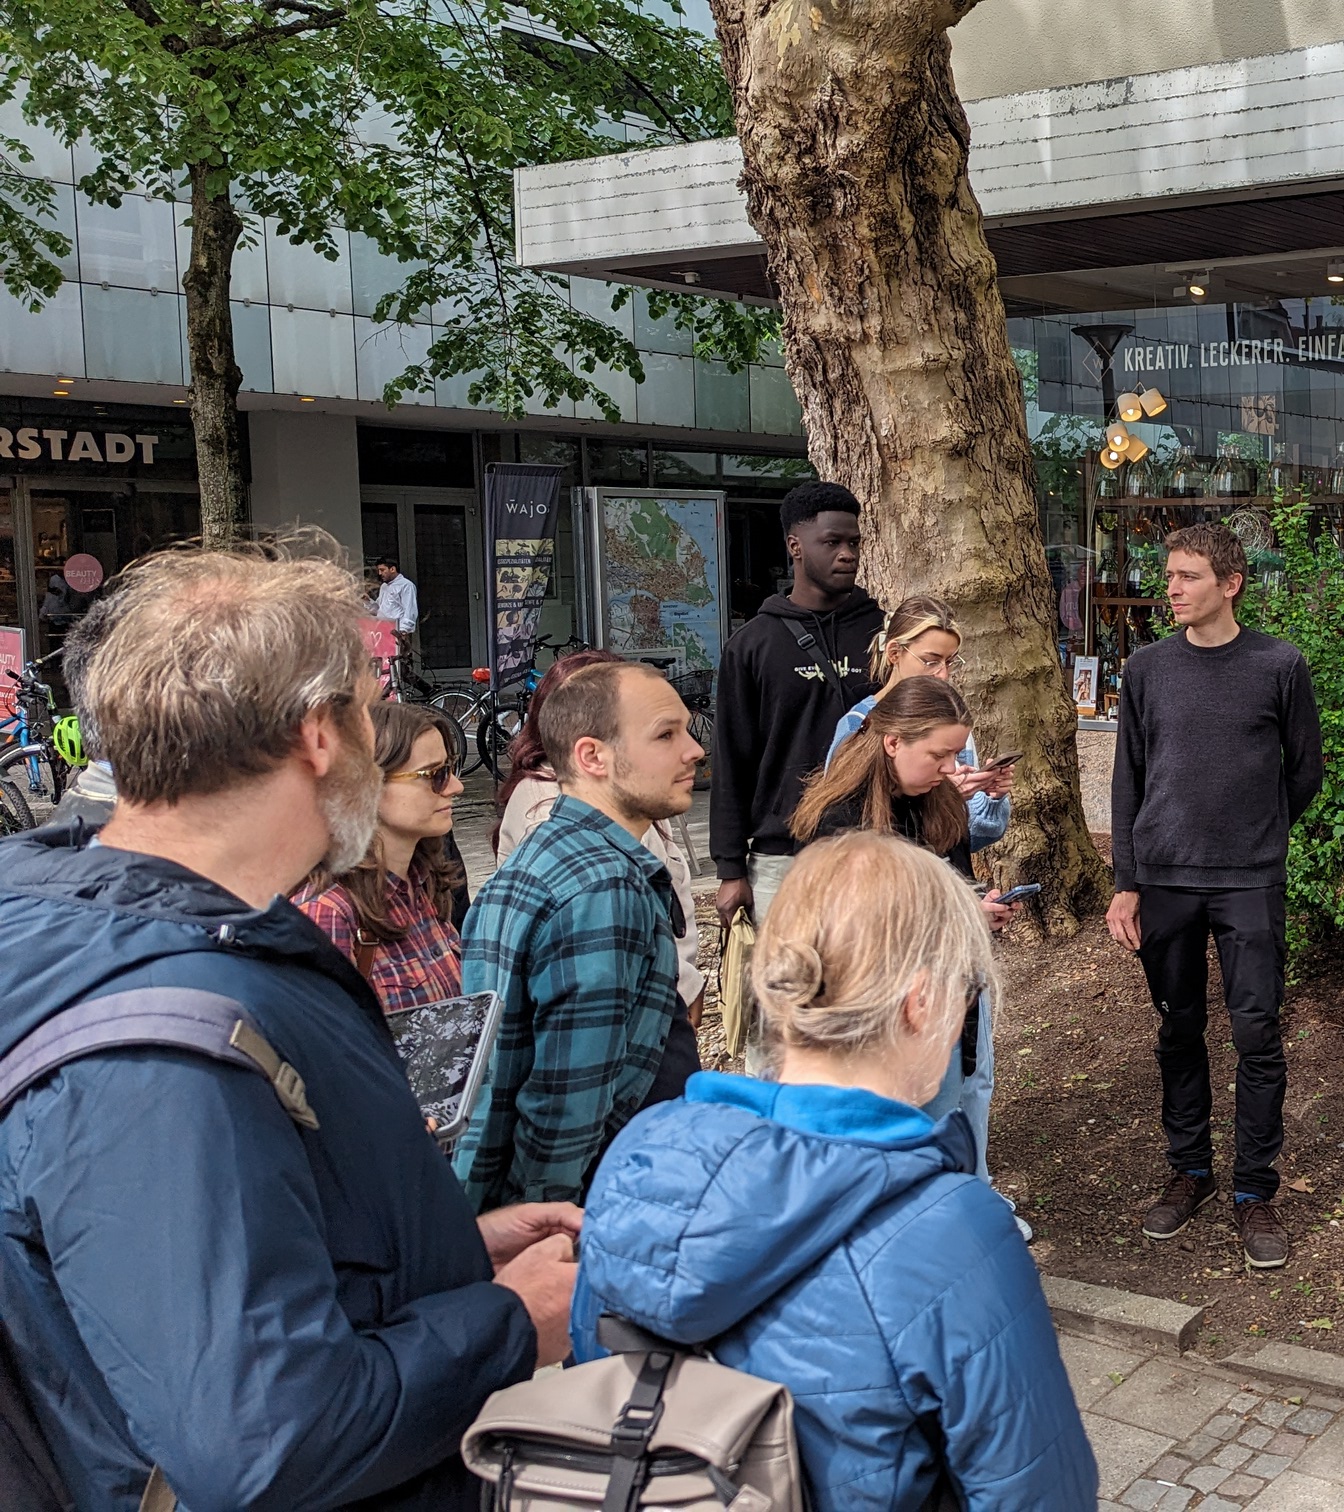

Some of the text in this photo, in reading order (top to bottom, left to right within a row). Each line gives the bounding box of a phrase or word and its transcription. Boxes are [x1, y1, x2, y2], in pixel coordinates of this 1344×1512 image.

[1124, 344, 1193, 372] KREATIV.
[1200, 337, 1290, 368] LECKERER.
[0, 427, 159, 464] RSTADT
[65, 570, 97, 578] BEAUTY
